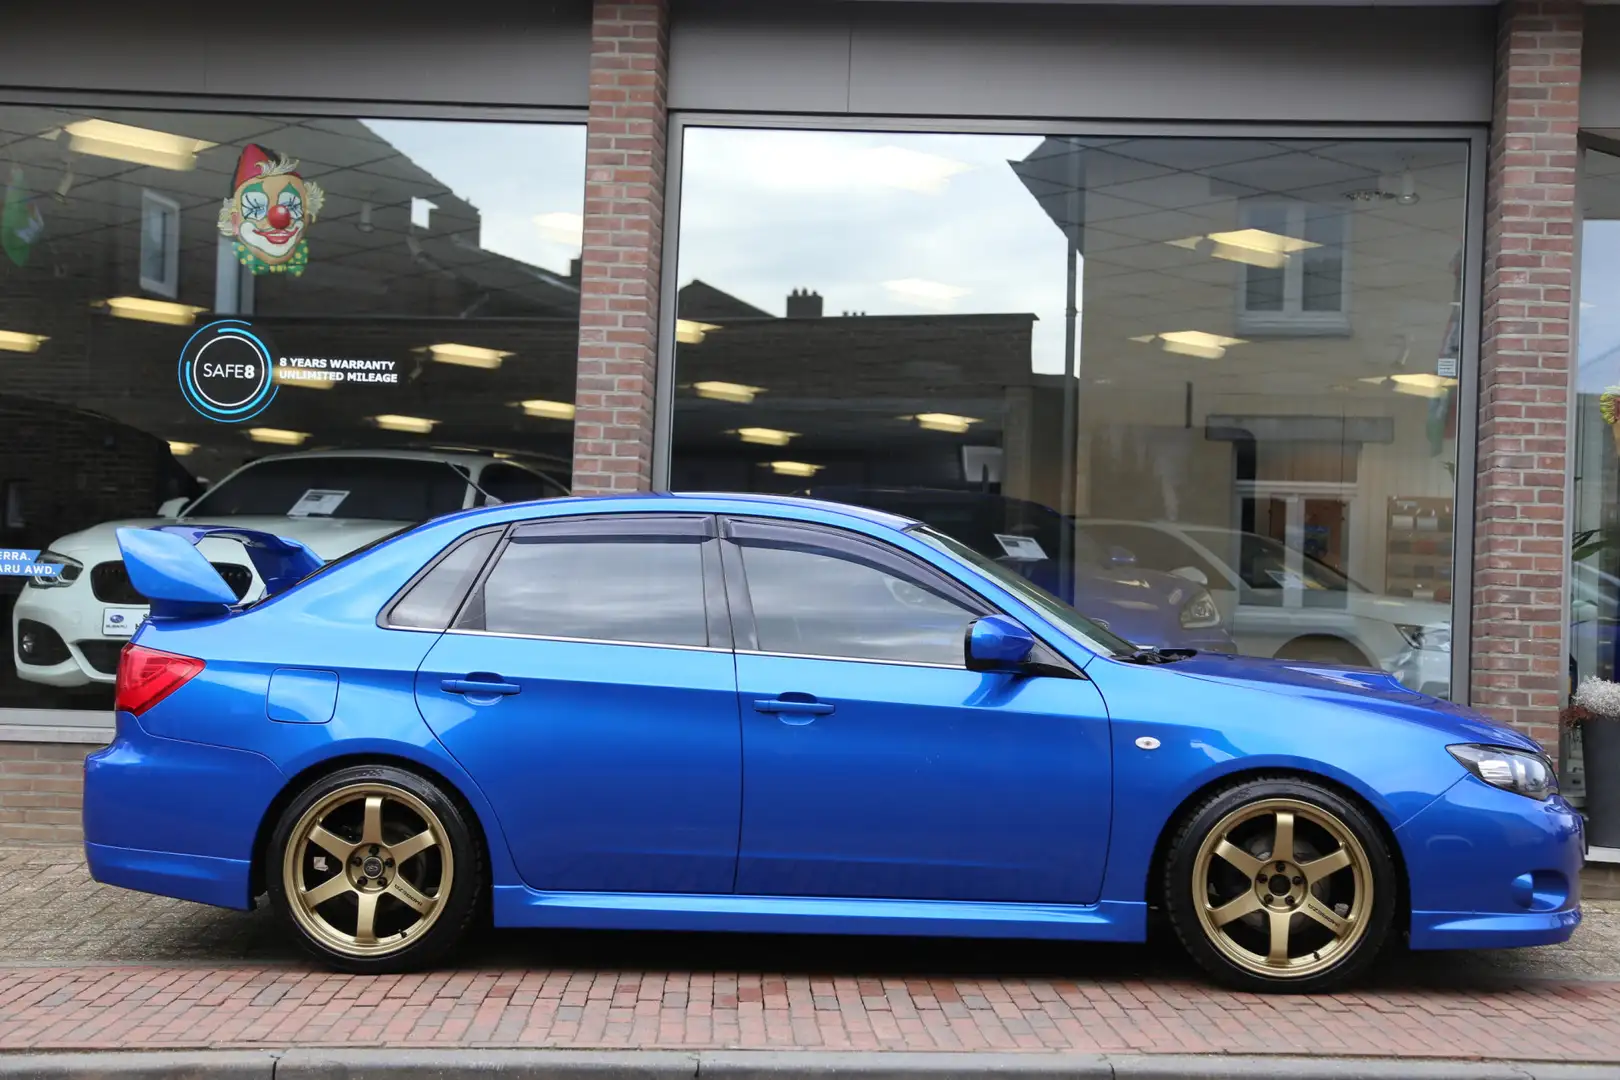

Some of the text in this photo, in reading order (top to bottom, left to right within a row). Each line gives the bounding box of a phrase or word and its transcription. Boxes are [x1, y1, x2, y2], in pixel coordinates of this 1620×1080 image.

[279, 357, 395, 370] 8 YEARS WARRANTY
[203, 362, 255, 379] SAFE8
[279, 370, 398, 383] UNLIMITED MILEAGE
[24, 565, 56, 575] AWD.
